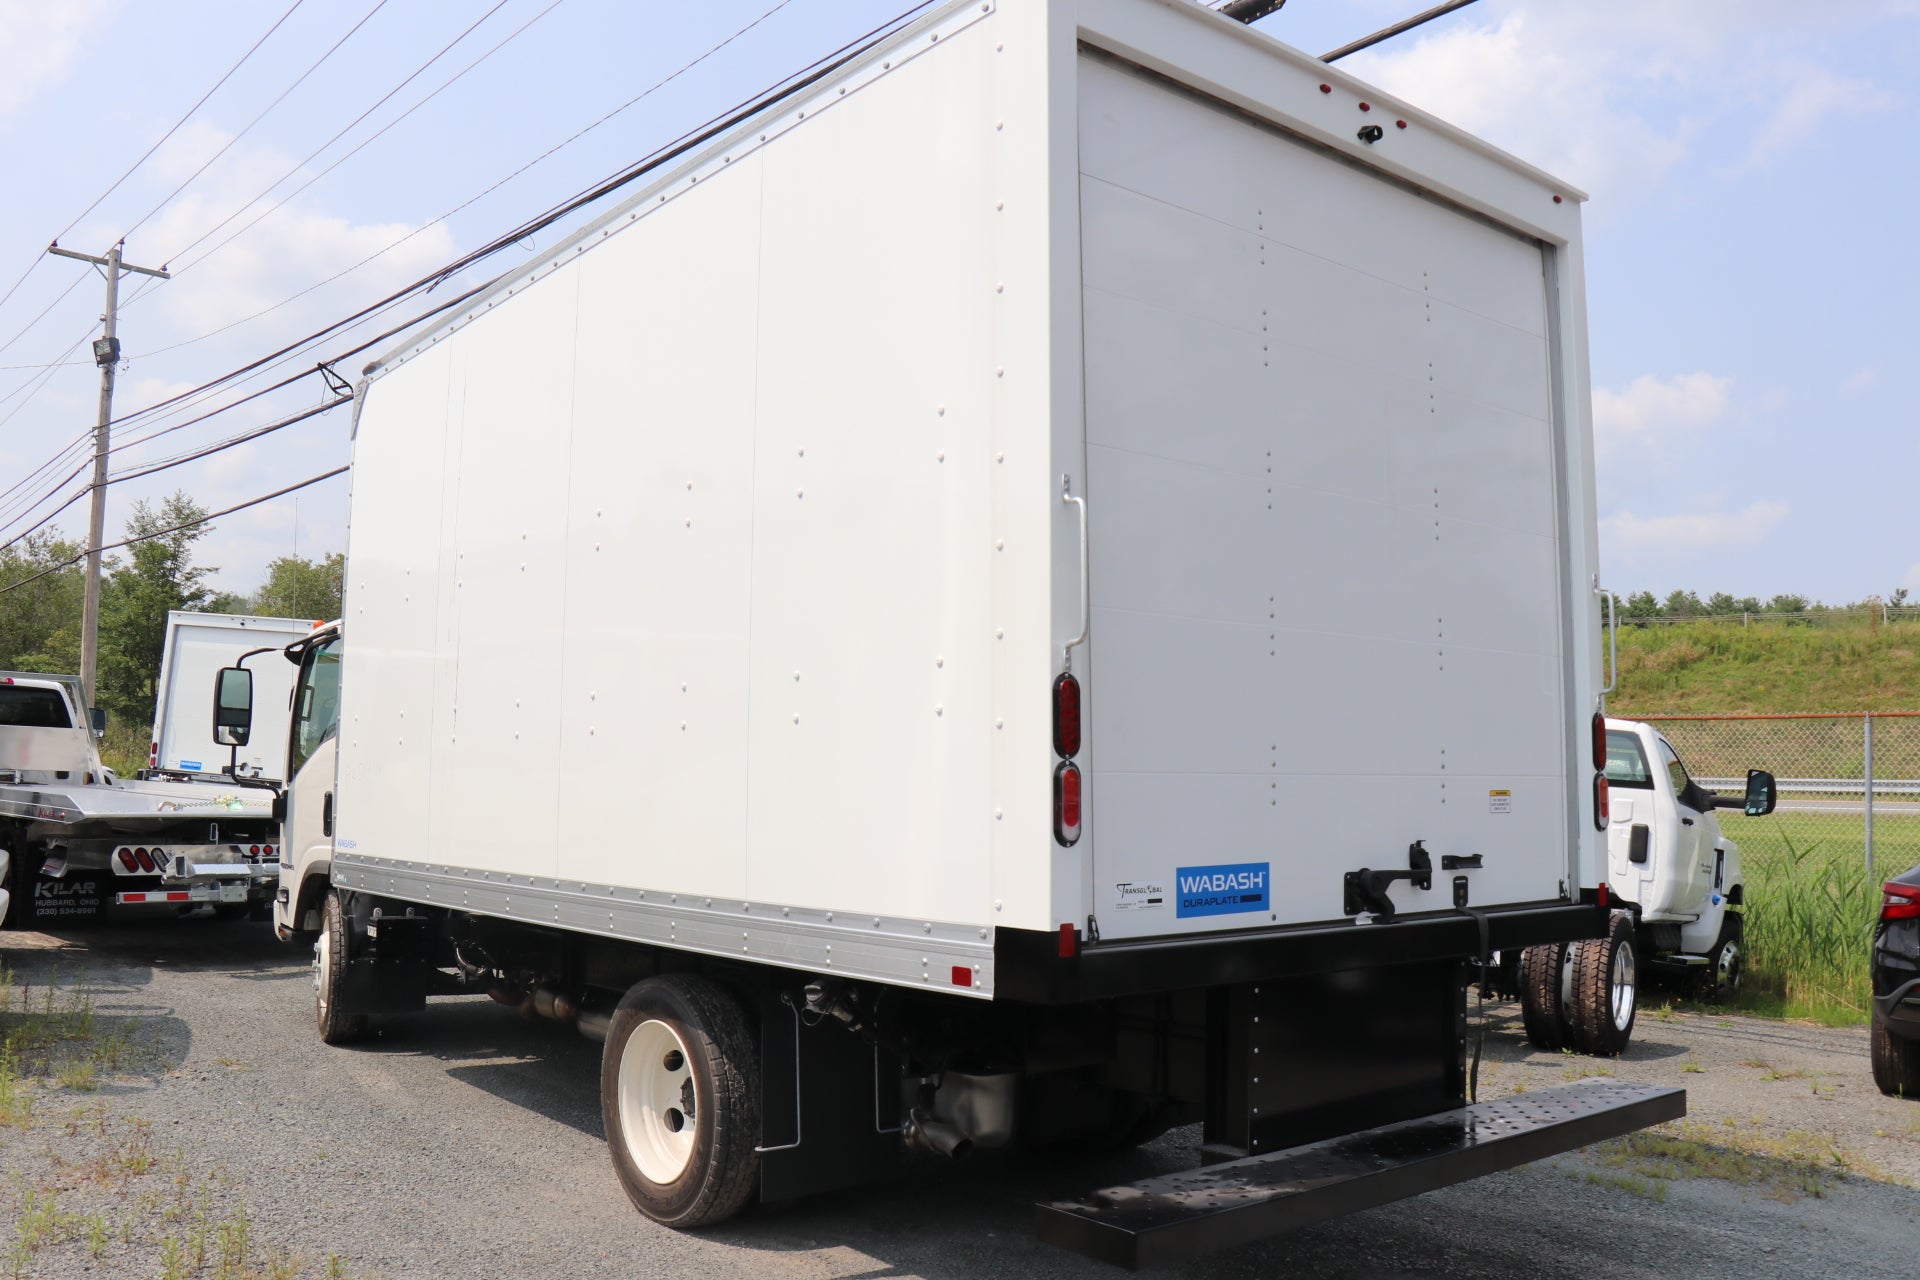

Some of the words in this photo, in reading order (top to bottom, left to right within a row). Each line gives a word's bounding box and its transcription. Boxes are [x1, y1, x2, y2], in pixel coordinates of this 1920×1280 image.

[1180, 871, 1263, 894] WABASH
[34, 882, 96, 898] KILAR
[35, 899, 77, 907] HUBBARD,
[80, 898, 99, 906] OHIO
[1183, 895, 1239, 908] DURAPLATE
[36, 908, 58, 916] (330)
